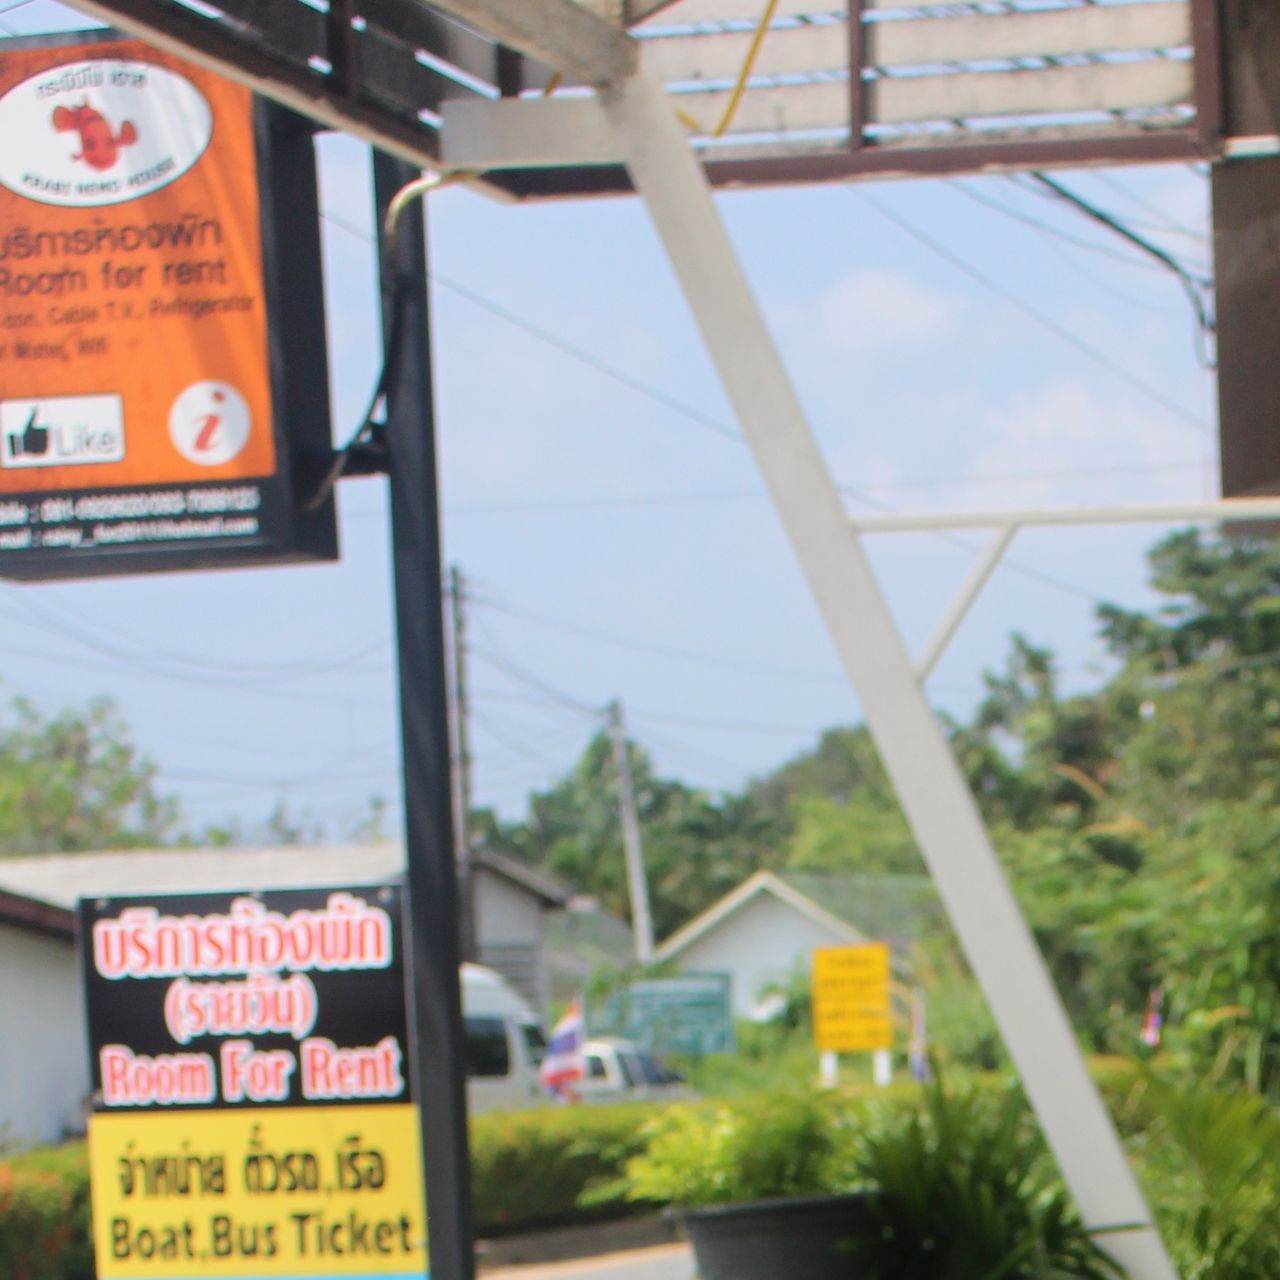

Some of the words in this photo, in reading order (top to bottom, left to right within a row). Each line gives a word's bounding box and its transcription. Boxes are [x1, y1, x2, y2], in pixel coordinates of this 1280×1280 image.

[101, 260, 146, 289] for
[163, 258, 227, 285] rent
[54, 422, 117, 457] Like
[97, 897, 390, 975] บริการห้องพัก
[102, 1047, 214, 1104] Room
[222, 1041, 295, 1101] For
[303, 1038, 402, 1099] Rent
[291, 1211, 412, 1255] Ticket
